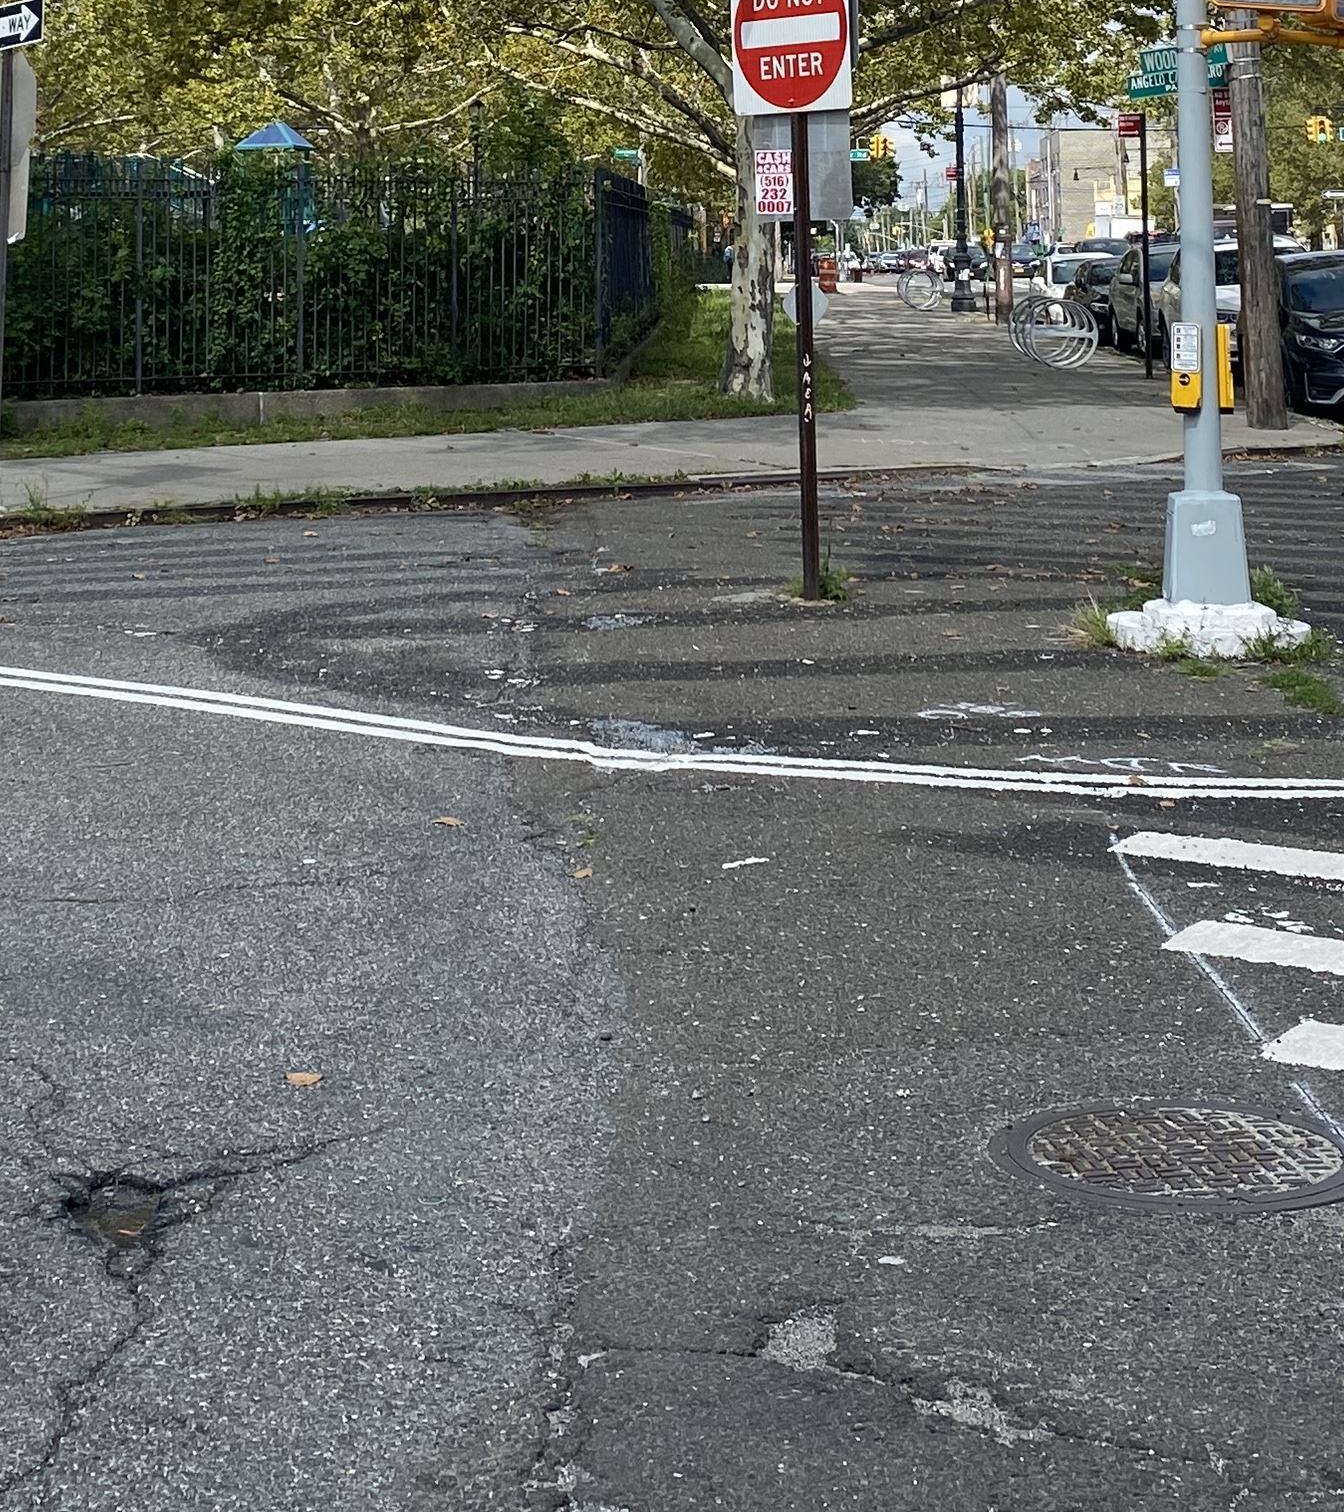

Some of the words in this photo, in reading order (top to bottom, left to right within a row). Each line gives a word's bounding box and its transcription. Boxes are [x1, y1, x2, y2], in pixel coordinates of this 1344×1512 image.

[8, 14, 31, 33] WAY
[759, 51, 824, 82] ENTER
[1130, 72, 1166, 90] ANGELO
[757, 152, 791, 164] CASH
[760, 175, 789, 188] (516)
[761, 187, 788, 200] 232
[758, 200, 792, 213] 0007
